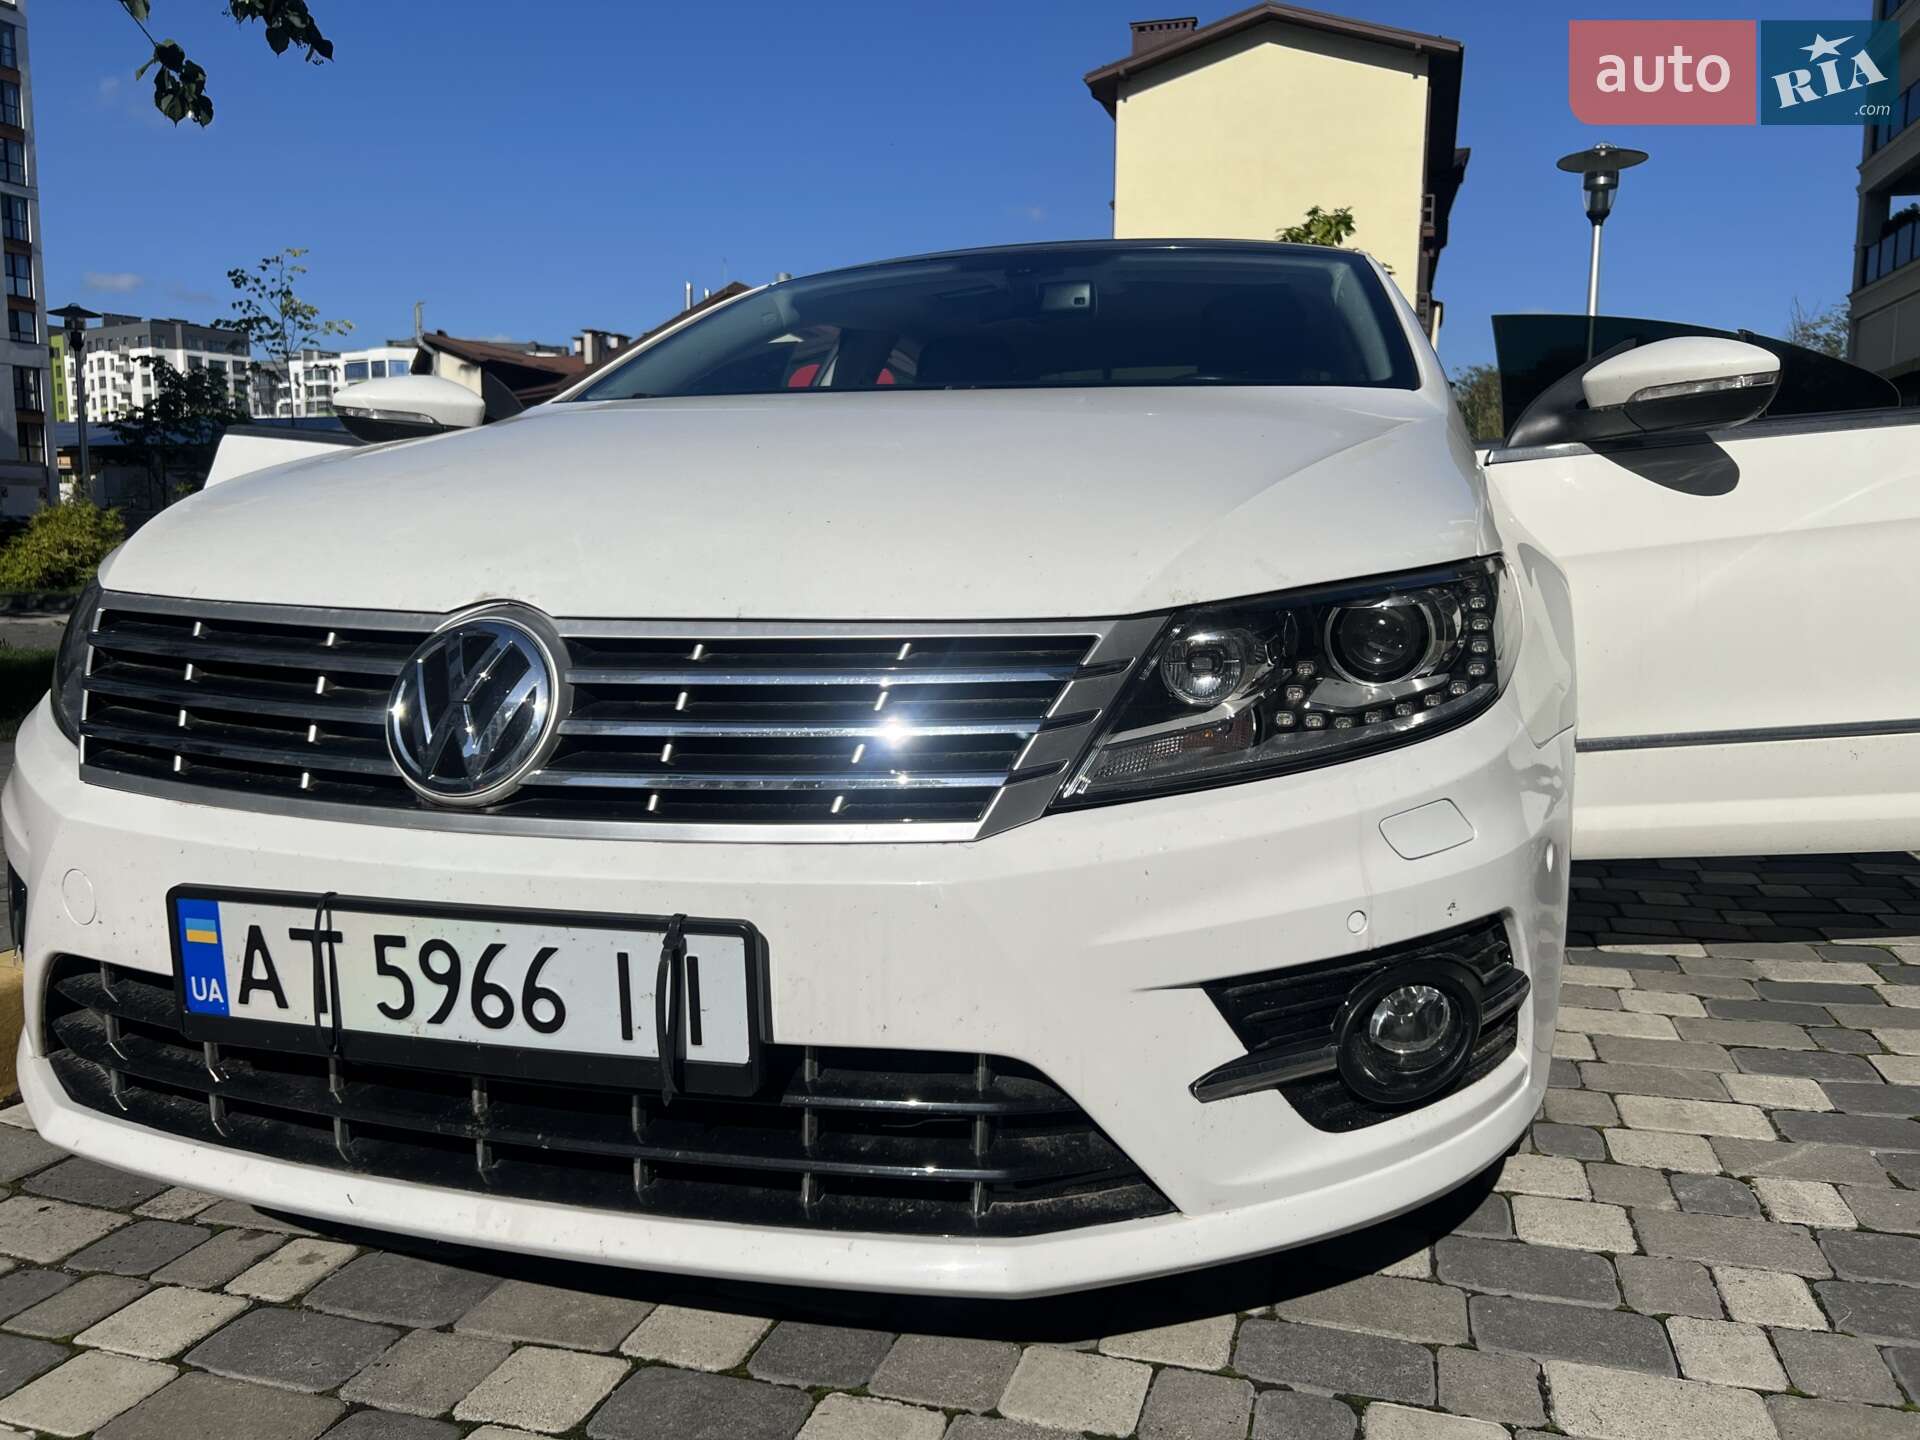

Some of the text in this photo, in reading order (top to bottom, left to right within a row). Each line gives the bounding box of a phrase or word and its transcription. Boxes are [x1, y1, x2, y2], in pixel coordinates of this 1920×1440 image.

[190, 975, 224, 1004] UA
[238, 924, 344, 1014] AT
[373, 934, 567, 1034] 5966
